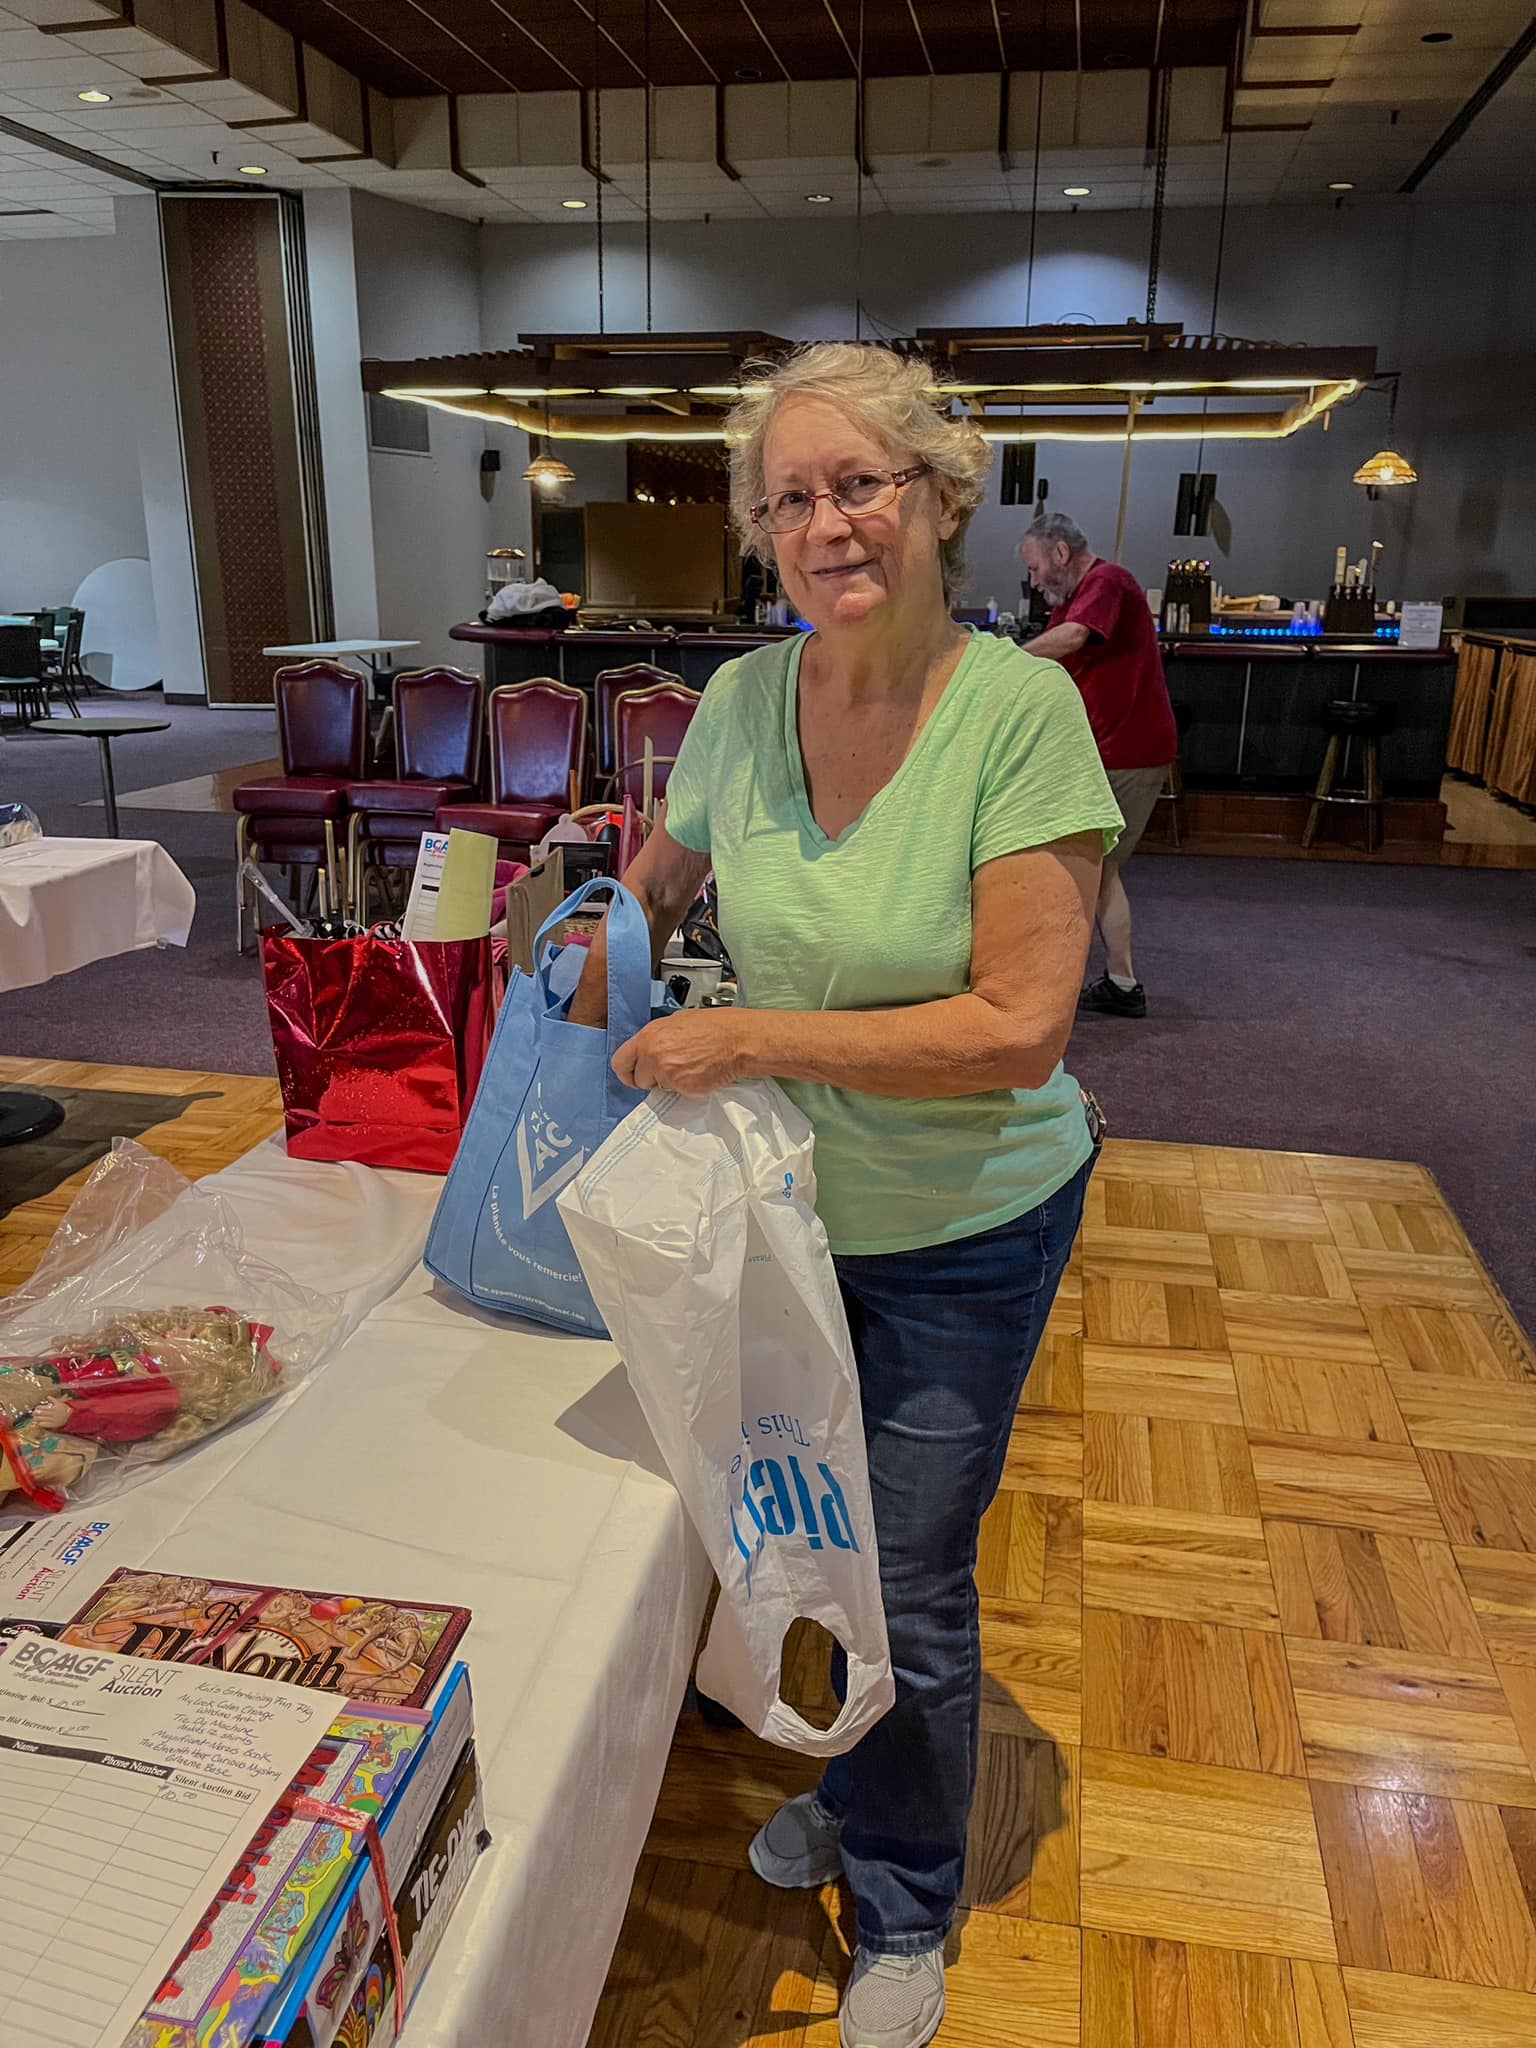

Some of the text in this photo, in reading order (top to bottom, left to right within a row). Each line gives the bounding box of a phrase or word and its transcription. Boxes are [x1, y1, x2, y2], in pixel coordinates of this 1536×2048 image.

[508, 1244, 532, 1264] vous
[533, 1261, 584, 1283] remercie!
[757, 1413, 811, 1447] This
[16, 1567, 55, 1601] Auction
[99, 1679, 163, 1698] Auction
[113, 1664, 184, 1687] SILENT
[12, 1740, 252, 1801] Name Phone Number Silent Auction Bid
